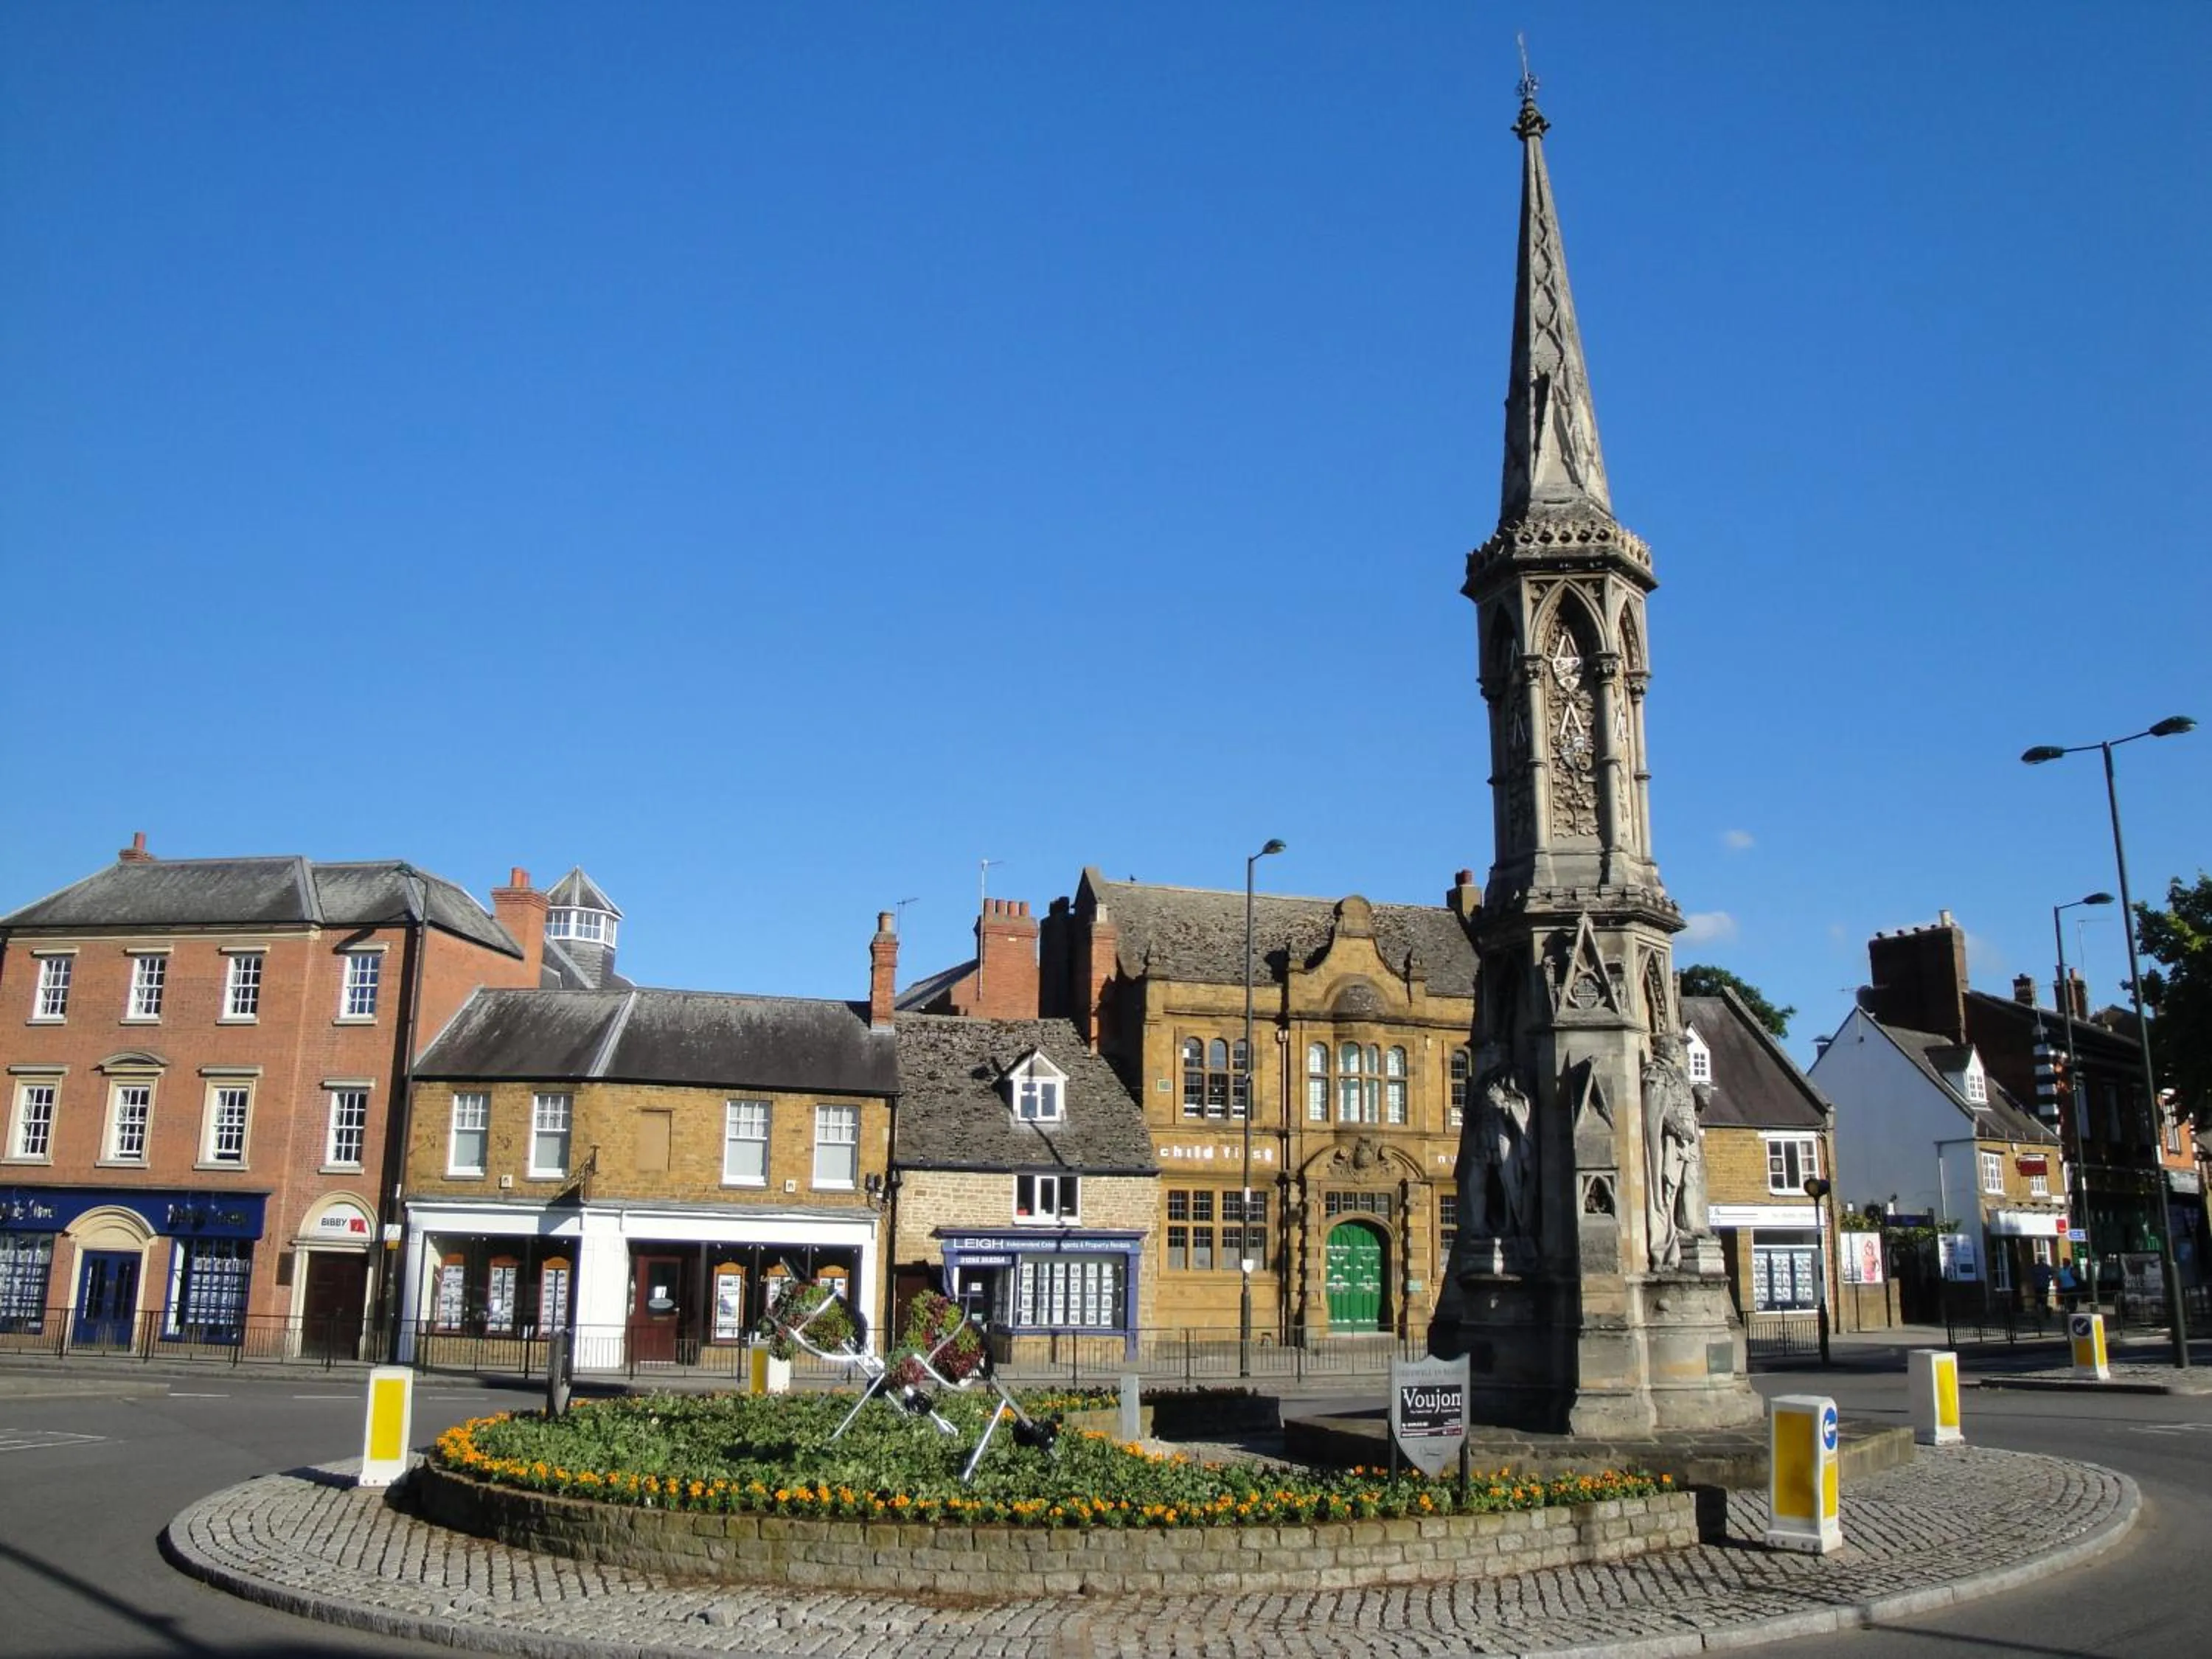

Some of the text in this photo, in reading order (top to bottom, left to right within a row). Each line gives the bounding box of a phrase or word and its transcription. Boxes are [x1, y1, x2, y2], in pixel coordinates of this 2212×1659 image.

[1160, 1145, 1273, 1161] child fist
[953, 1238, 1004, 1249] LEIGH
[1402, 1388, 1461, 1413] Voujon
